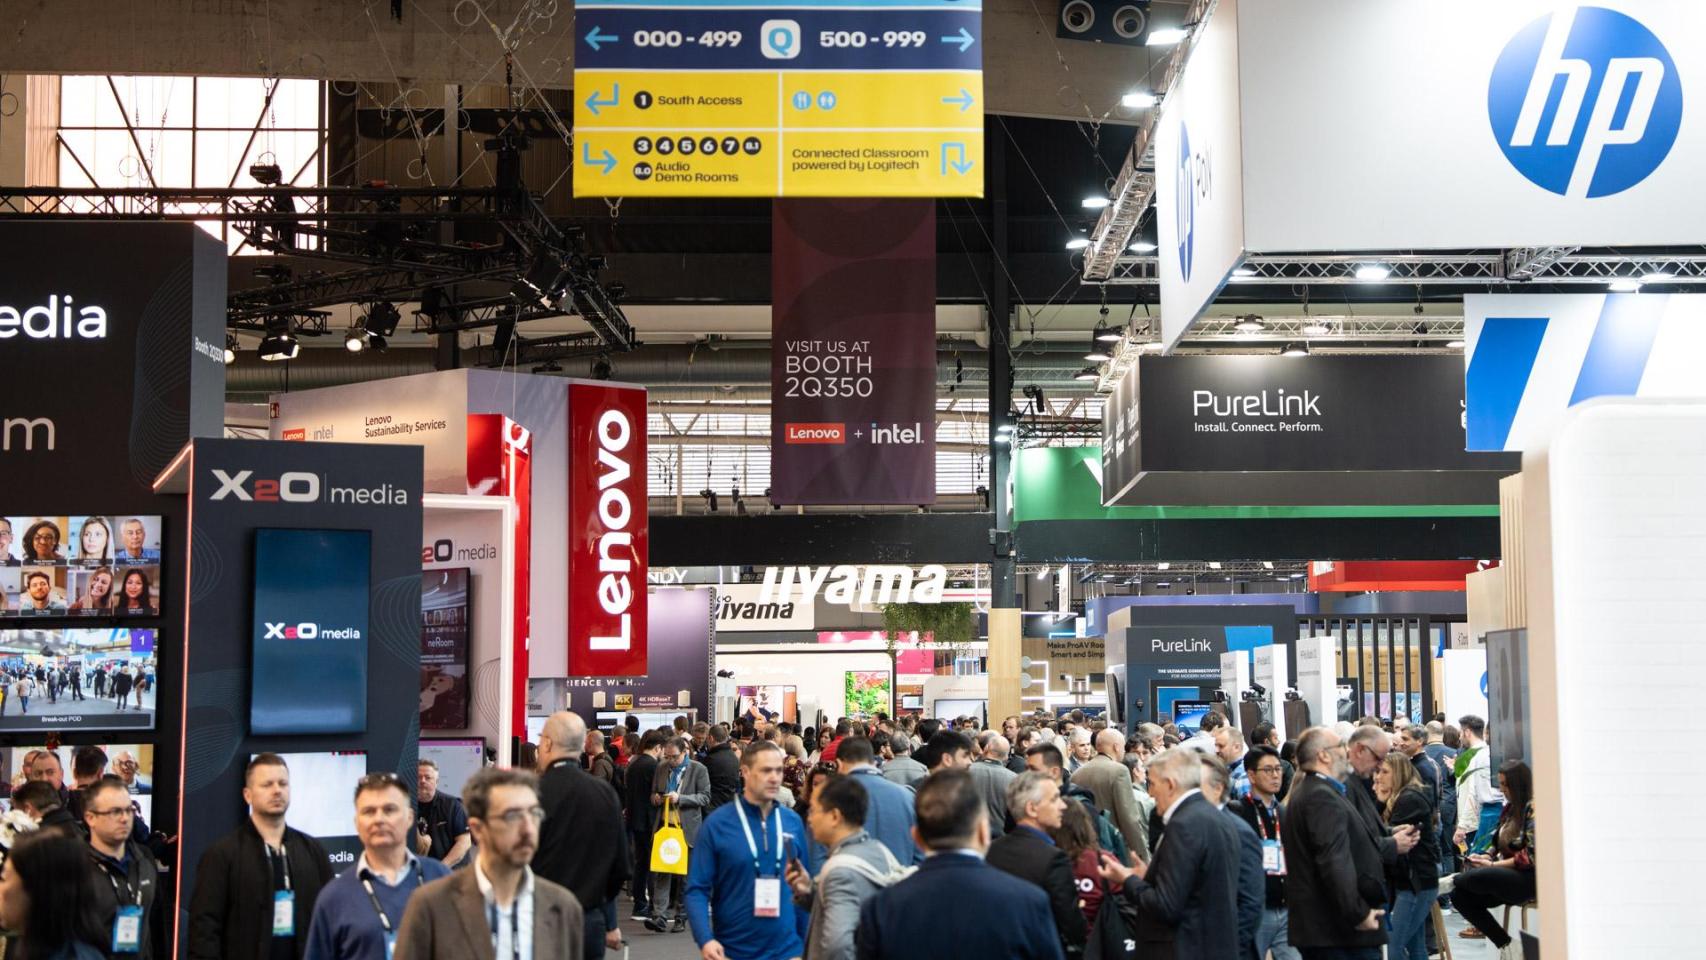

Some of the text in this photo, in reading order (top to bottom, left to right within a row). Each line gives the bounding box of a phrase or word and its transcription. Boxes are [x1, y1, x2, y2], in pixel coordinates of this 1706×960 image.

[633, 31, 682, 47] 000
[699, 31, 742, 47] 499
[768, 27, 793, 56] Q
[820, 31, 866, 48] 500
[883, 31, 926, 48] 999
[658, 95, 695, 106] South
[697, 95, 743, 106] Access
[1490, 7, 1682, 198] hp
[792, 148, 930, 159] Connected Classroom
[655, 162, 690, 172] Audio
[792, 160, 920, 172] powered by Logitech
[655, 173, 739, 183] Demo Rooms
[0, 294, 107, 338] edia
[785, 340, 871, 353] VISIT US AT
[785, 355, 872, 374] BOOTH
[785, 377, 873, 398] 2Q350
[1193, 389, 1322, 416] PureLink
[365, 415, 392, 426] Lenovo
[1194, 421, 1324, 432] Install. Connect. Perform.
[365, 420, 447, 438] Sustainability Services
[790, 427, 840, 439] Lenovo
[331, 484, 408, 505] media
[589, 409, 632, 650] Lenovo
[457, 543, 497, 560] media
[321, 627, 361, 640] media
[1151, 638, 1212, 652] PureLink
[1050, 650, 1072, 658] Smart
[1073, 650, 1087, 658] and
